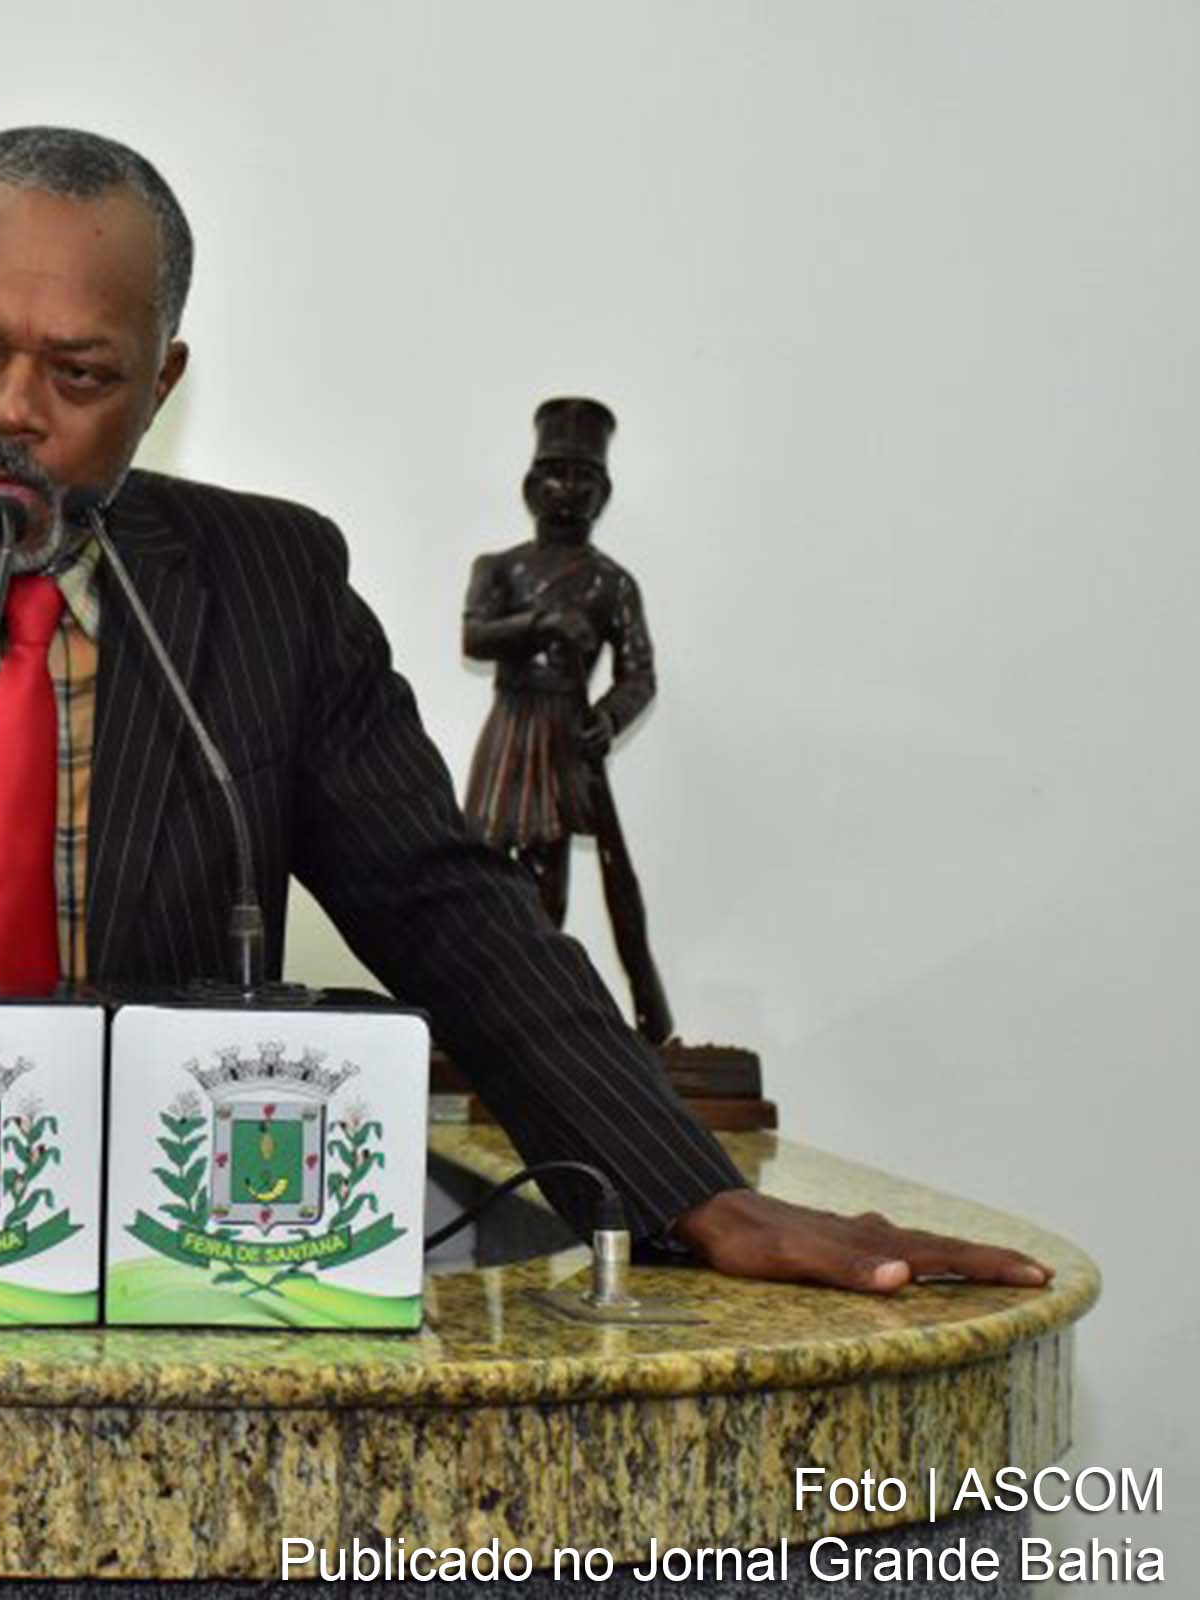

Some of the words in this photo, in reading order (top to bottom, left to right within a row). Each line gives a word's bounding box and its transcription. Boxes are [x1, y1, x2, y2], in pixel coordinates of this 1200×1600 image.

[183, 1232, 233, 1259] FEIRA
[238, 1245, 262, 1262] DE
[265, 1233, 346, 1262] SANTANA
